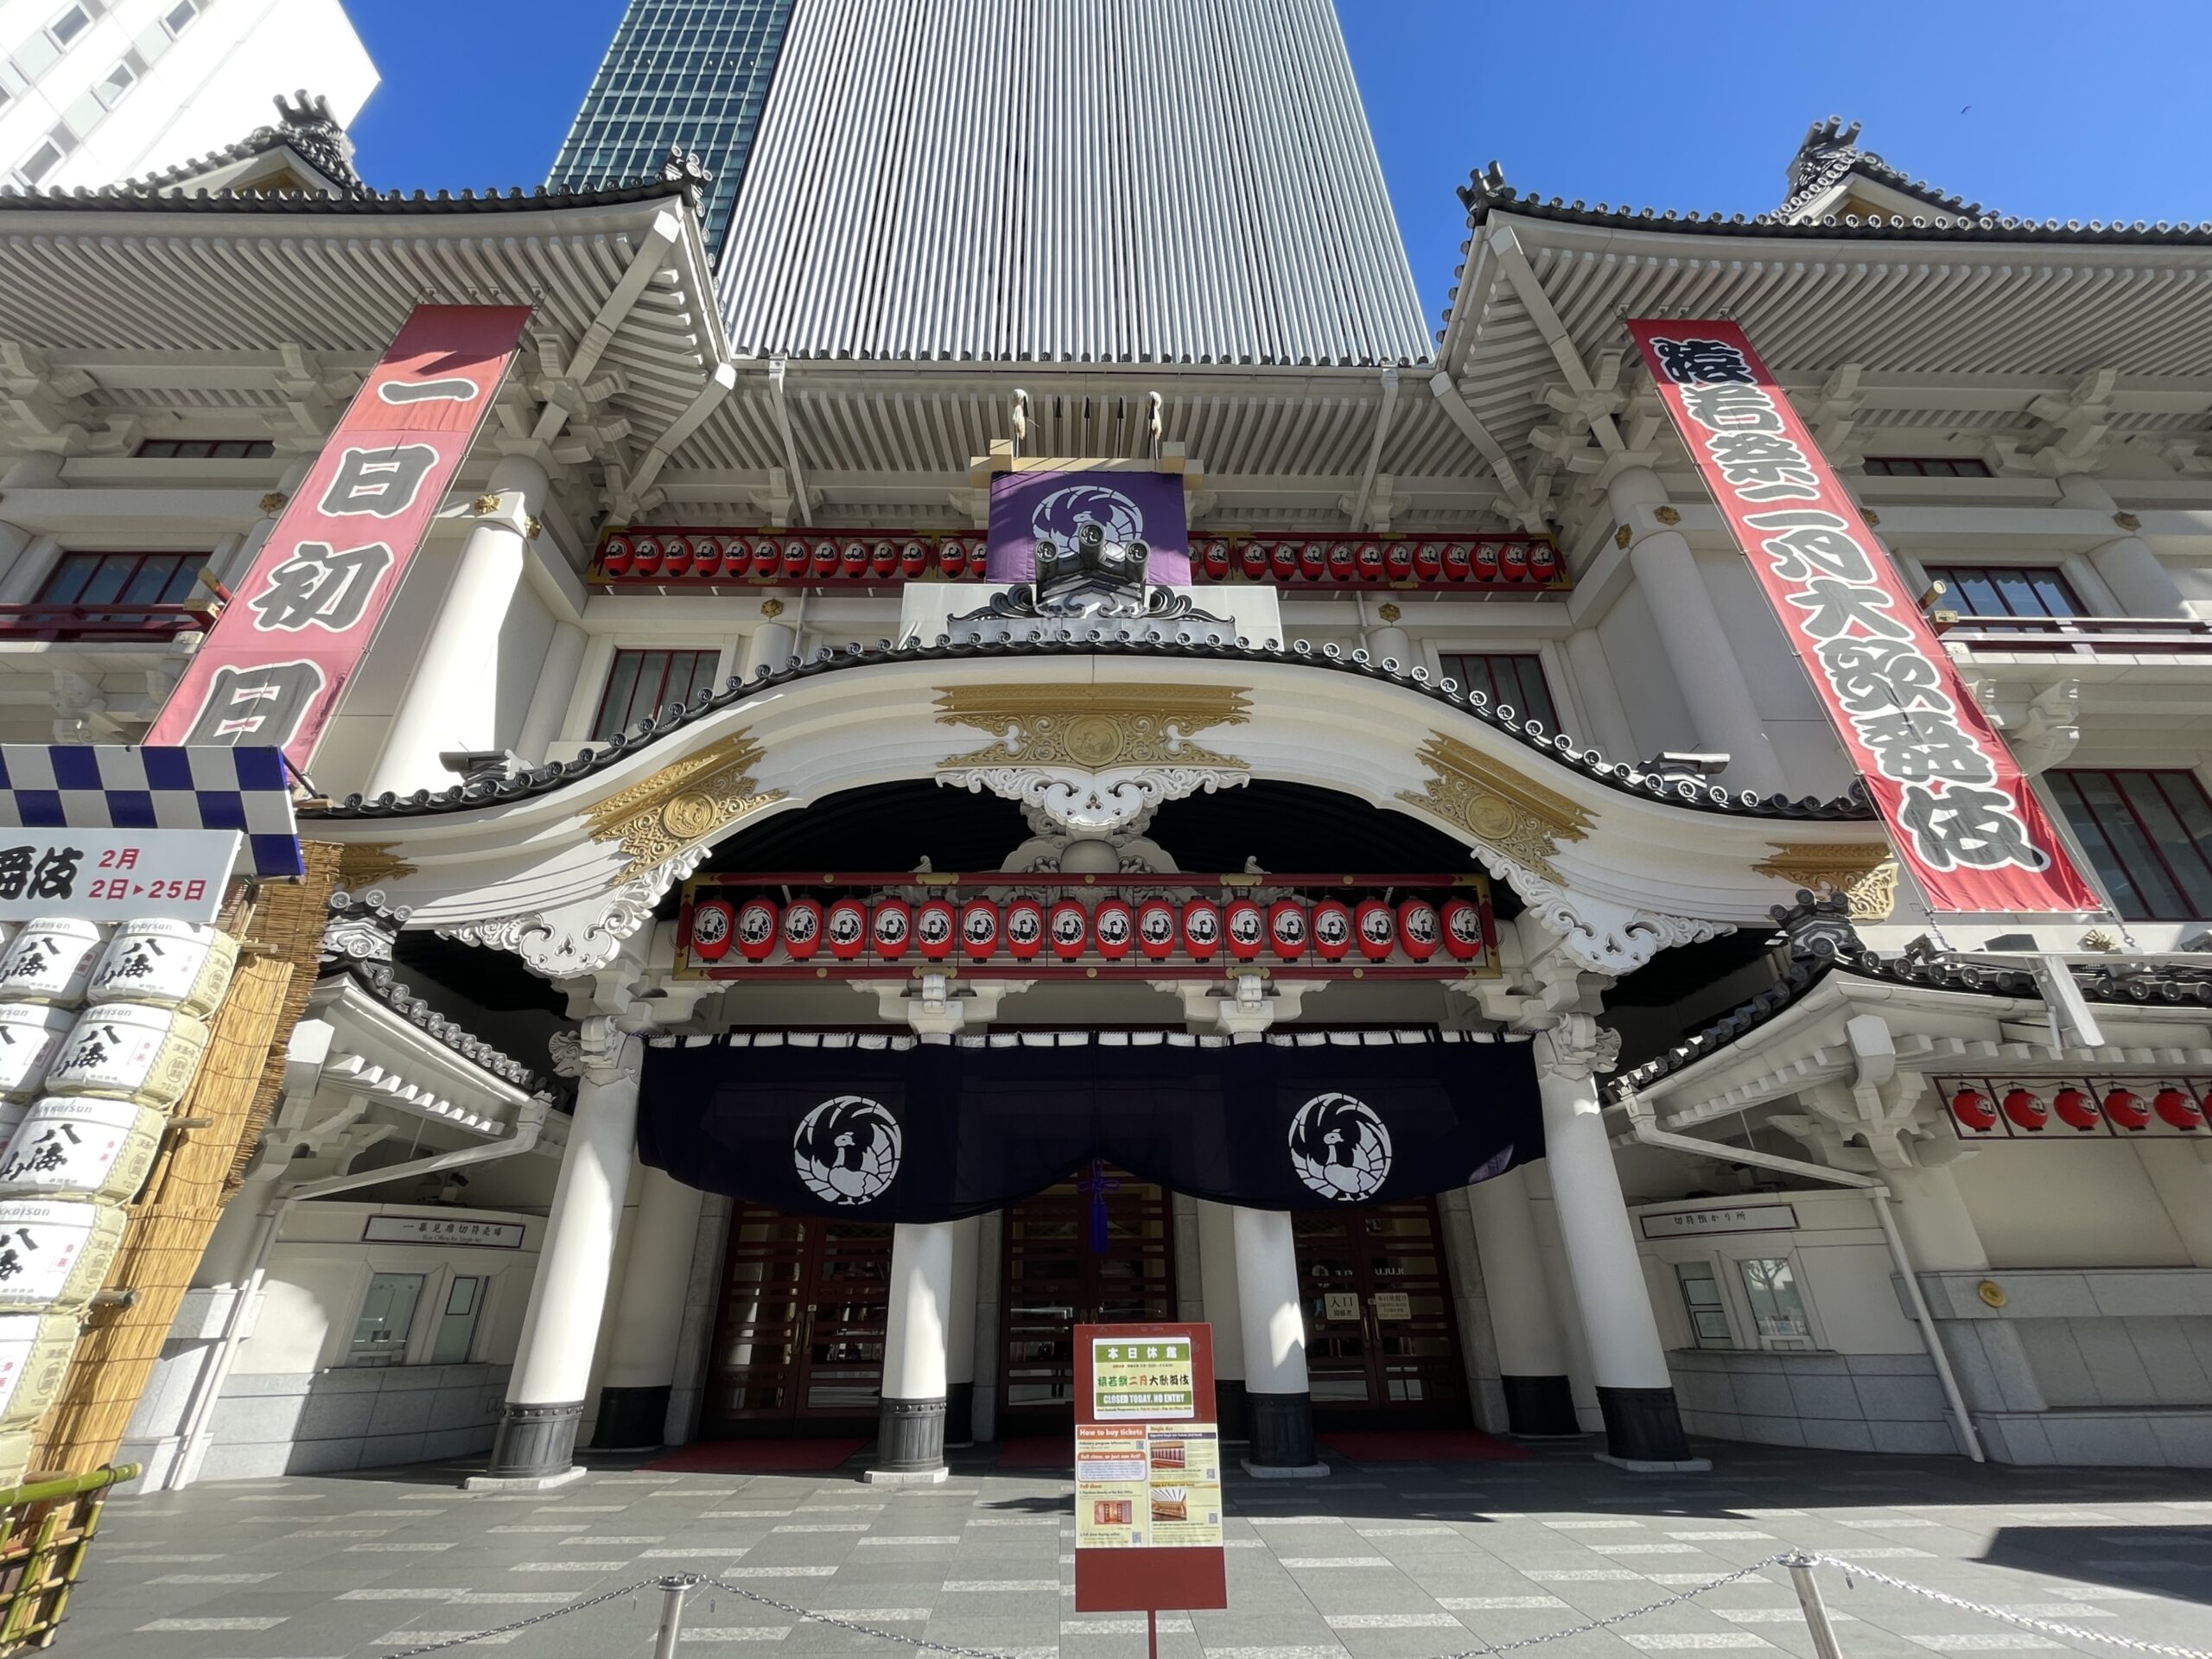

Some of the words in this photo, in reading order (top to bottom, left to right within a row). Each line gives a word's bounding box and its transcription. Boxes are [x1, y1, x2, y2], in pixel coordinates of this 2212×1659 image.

[98, 848, 141, 870] 2月
[1108, 1346, 1177, 1359] 本日休館
[1103, 1395, 1128, 1404] CLOSED
[1154, 1395, 1164, 1403] NO
[1165, 1394, 1185, 1403] ENTRY
[1106, 1428, 1118, 1437] buy
